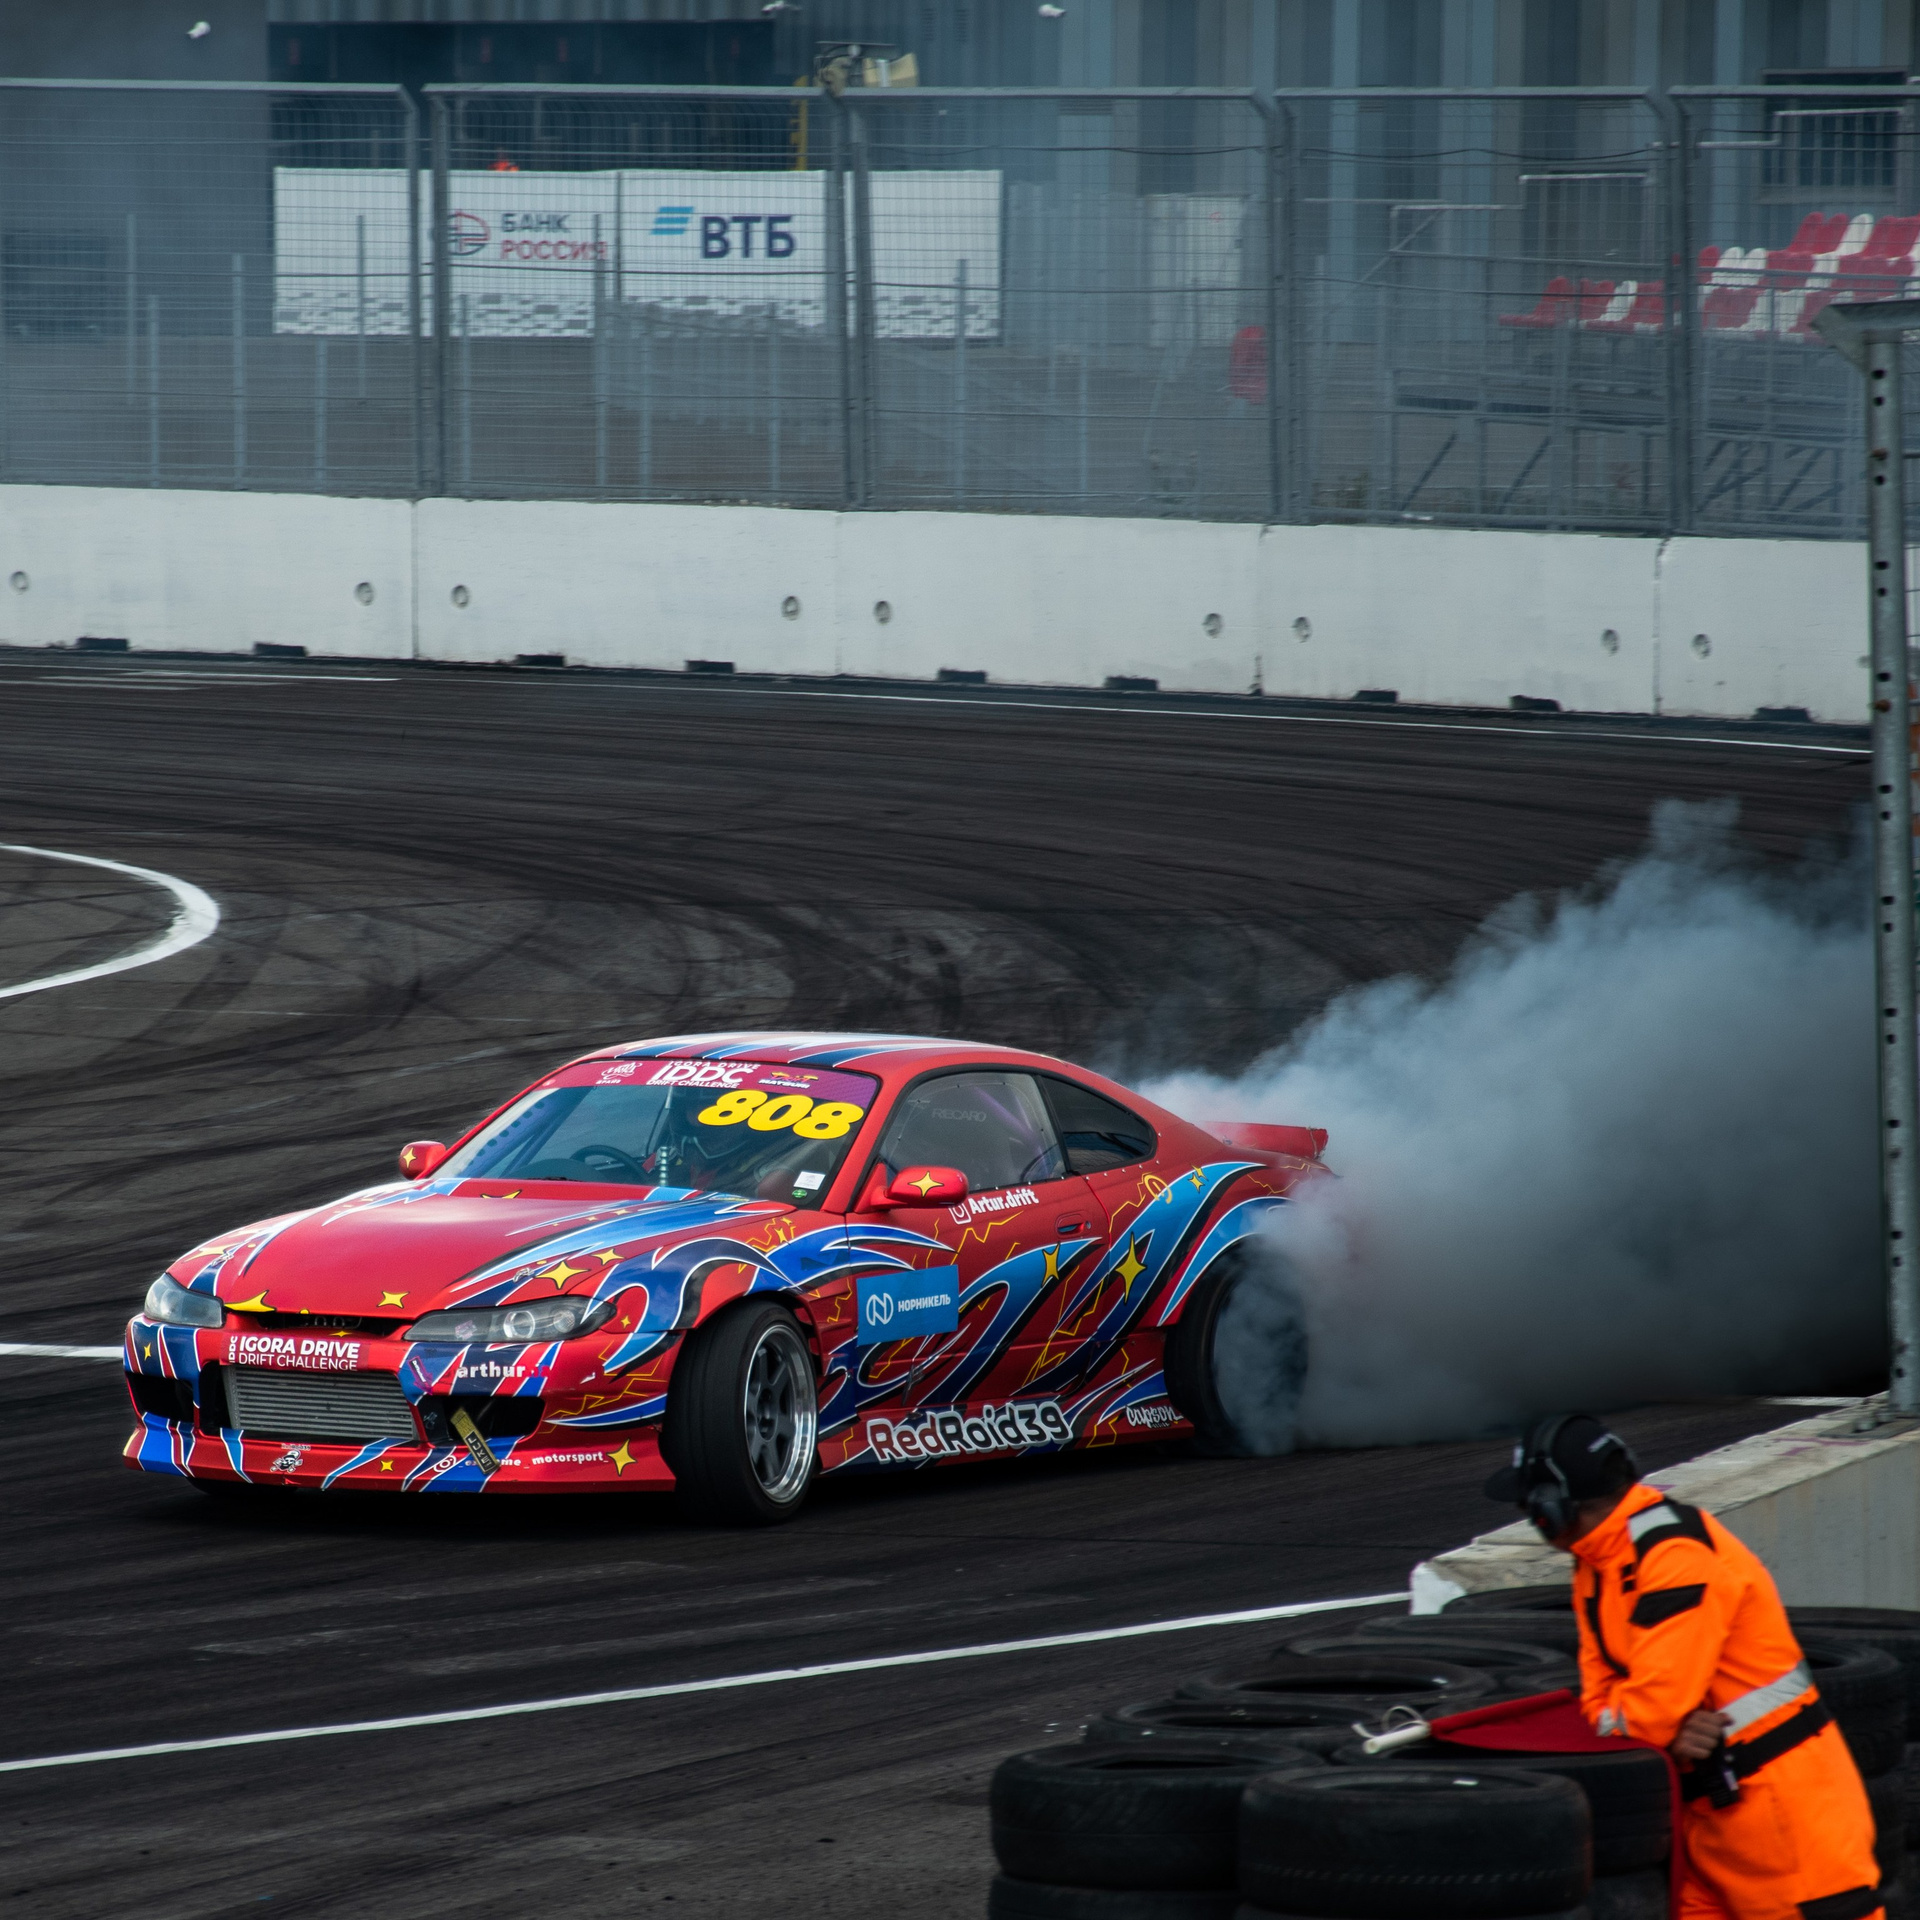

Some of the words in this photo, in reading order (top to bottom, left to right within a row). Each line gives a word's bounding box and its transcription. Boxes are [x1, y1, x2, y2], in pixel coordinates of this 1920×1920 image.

[502, 213, 571, 233] БАНК
[703, 215, 796, 259] ВТБ
[502, 240, 608, 261] РОССИЯ
[650, 1064, 754, 1084] IDDC
[668, 1060, 711, 1068] IGORA
[717, 1061, 761, 1070] DRIVE
[678, 1080, 740, 1089] CHALLENGE
[697, 1089, 864, 1140] 808
[967, 1187, 1040, 1215] Artur.drift
[897, 1294, 951, 1313] НОРНИКЕЛЬ
[228, 1336, 238, 1363] IDDC
[239, 1335, 296, 1355] IGORA
[300, 1339, 361, 1360] DRIVE
[238, 1352, 275, 1366] DRIFT
[276, 1354, 359, 1372] CHALLENGE
[866, 1401, 1074, 1465] RedRoid39
